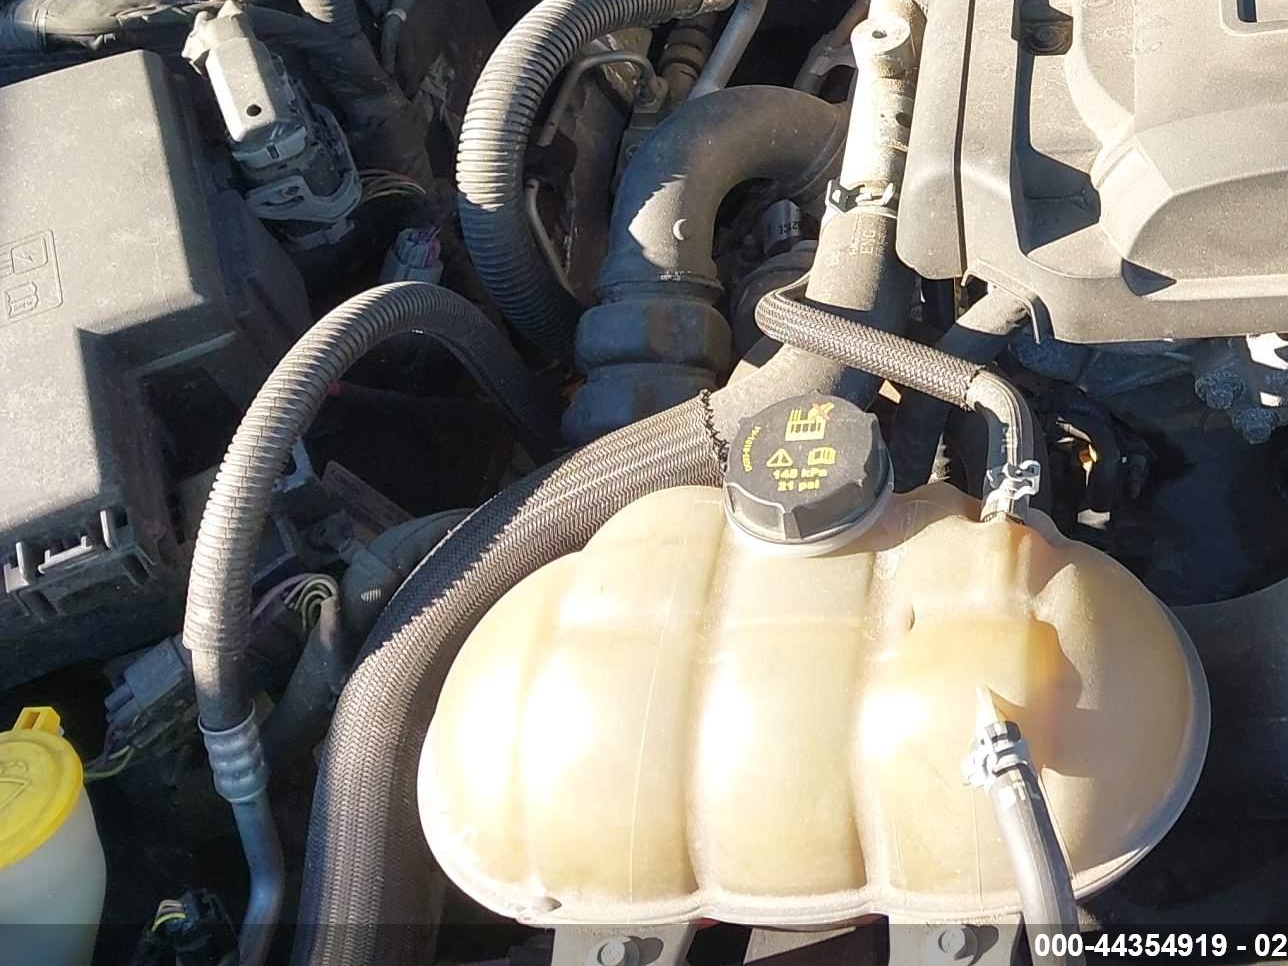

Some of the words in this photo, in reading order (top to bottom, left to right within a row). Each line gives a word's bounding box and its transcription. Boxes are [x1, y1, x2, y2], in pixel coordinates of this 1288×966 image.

[773, 468, 798, 481] 145
[800, 467, 828, 479] kPa
[777, 480, 795, 492] 21
[798, 478, 820, 492] psi
